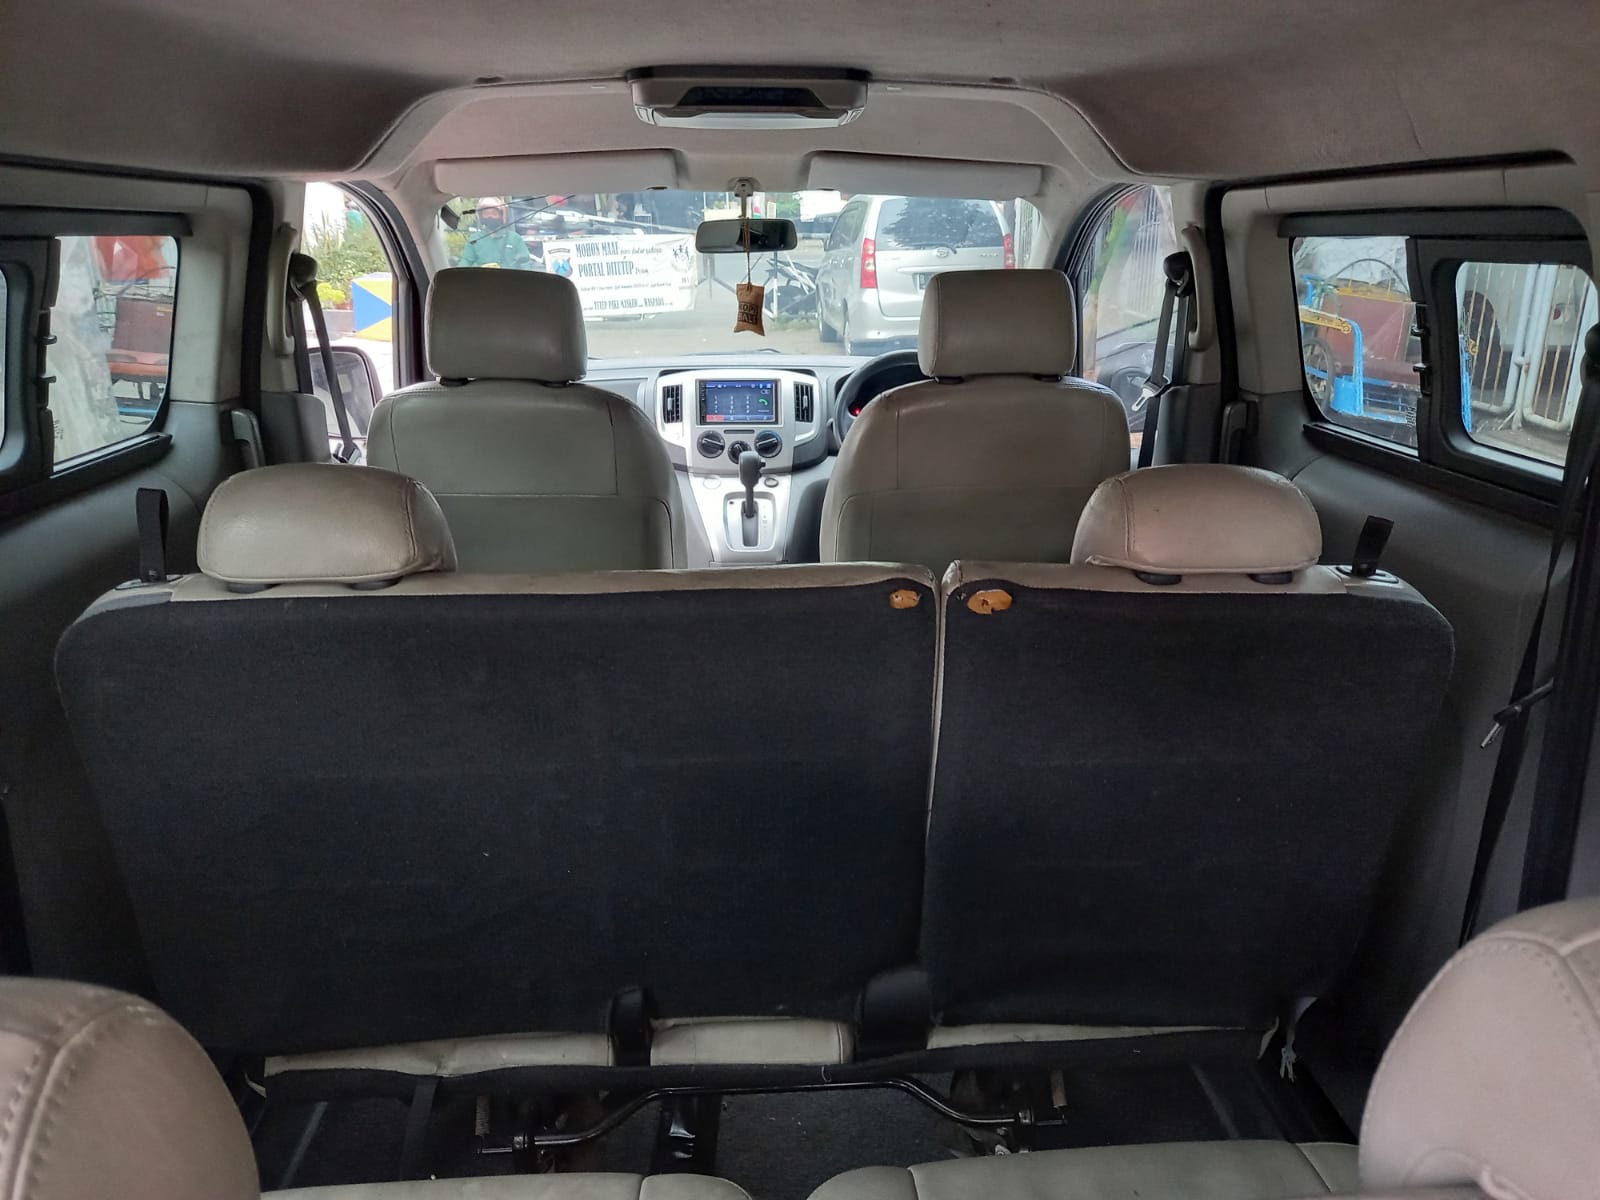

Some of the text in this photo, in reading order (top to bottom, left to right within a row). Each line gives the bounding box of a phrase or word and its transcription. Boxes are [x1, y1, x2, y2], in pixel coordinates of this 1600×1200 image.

[576, 242, 600, 257] MOHON
[601, 241, 619, 256] MAAF
[578, 262, 605, 277] PORTAL
[606, 260, 634, 276] DITUTUP
